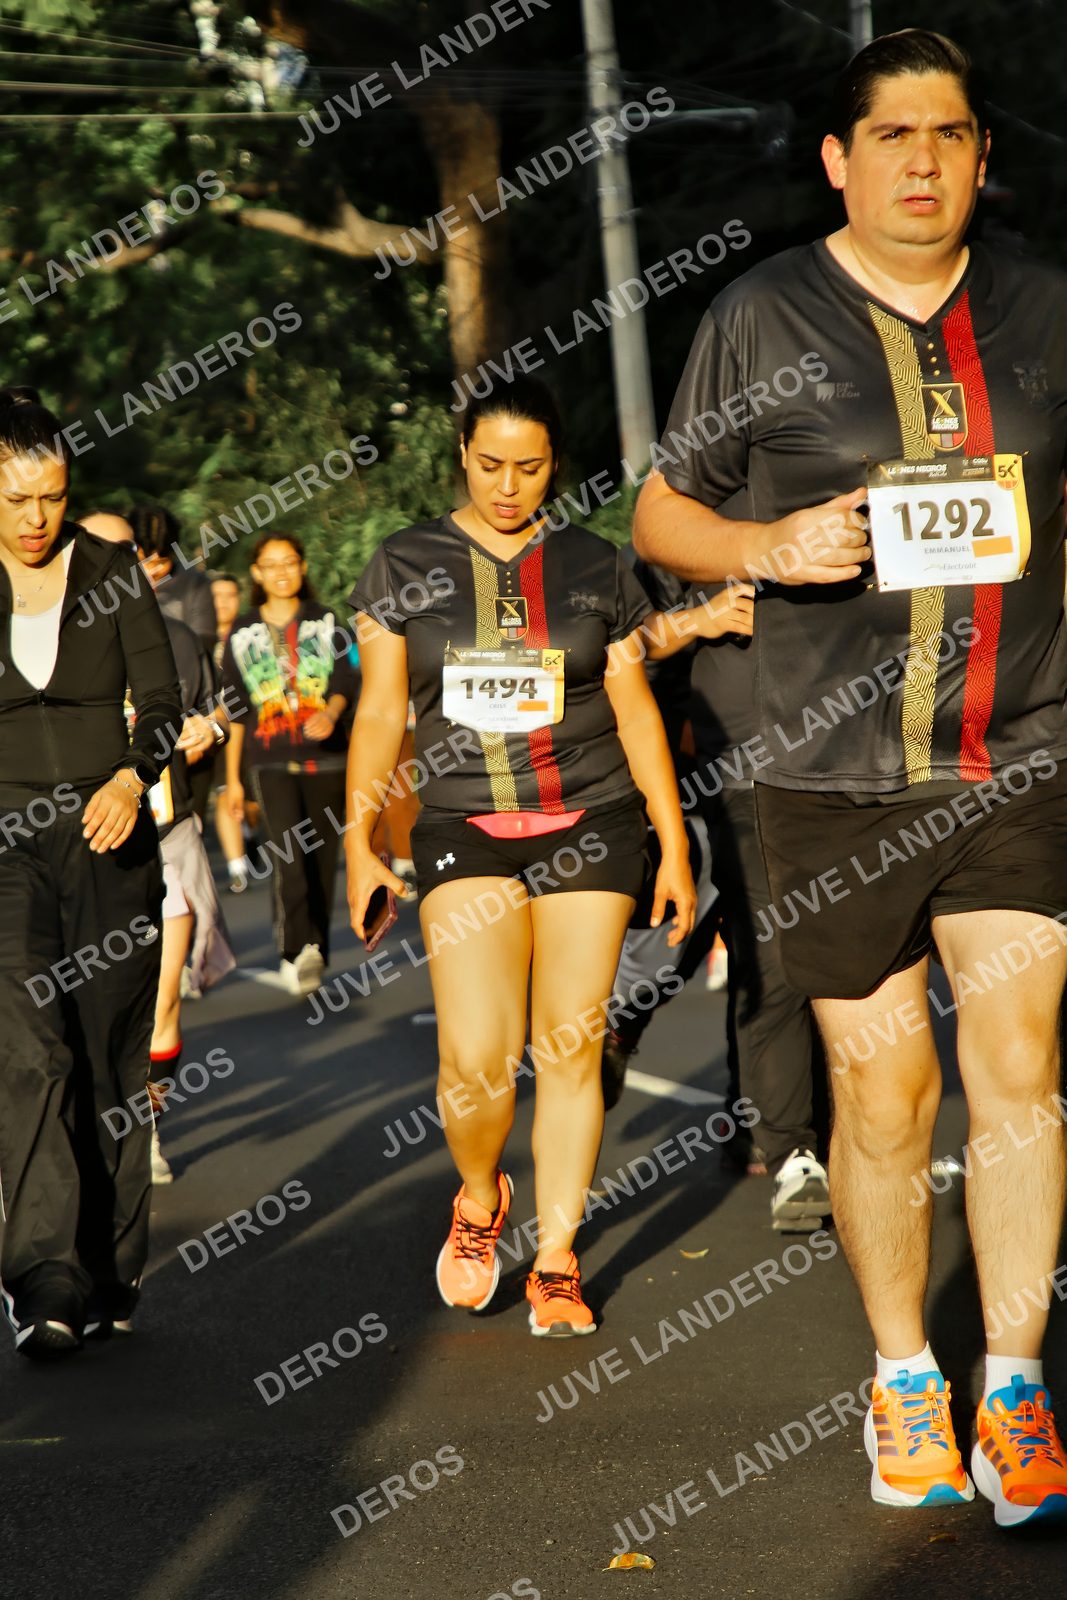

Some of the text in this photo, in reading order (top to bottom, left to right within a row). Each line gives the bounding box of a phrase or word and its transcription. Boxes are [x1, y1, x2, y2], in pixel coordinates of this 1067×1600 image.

[892, 497, 995, 541] 1292
[924, 545, 970, 554] EMMANUEL
[460, 678, 537, 699] 1494
